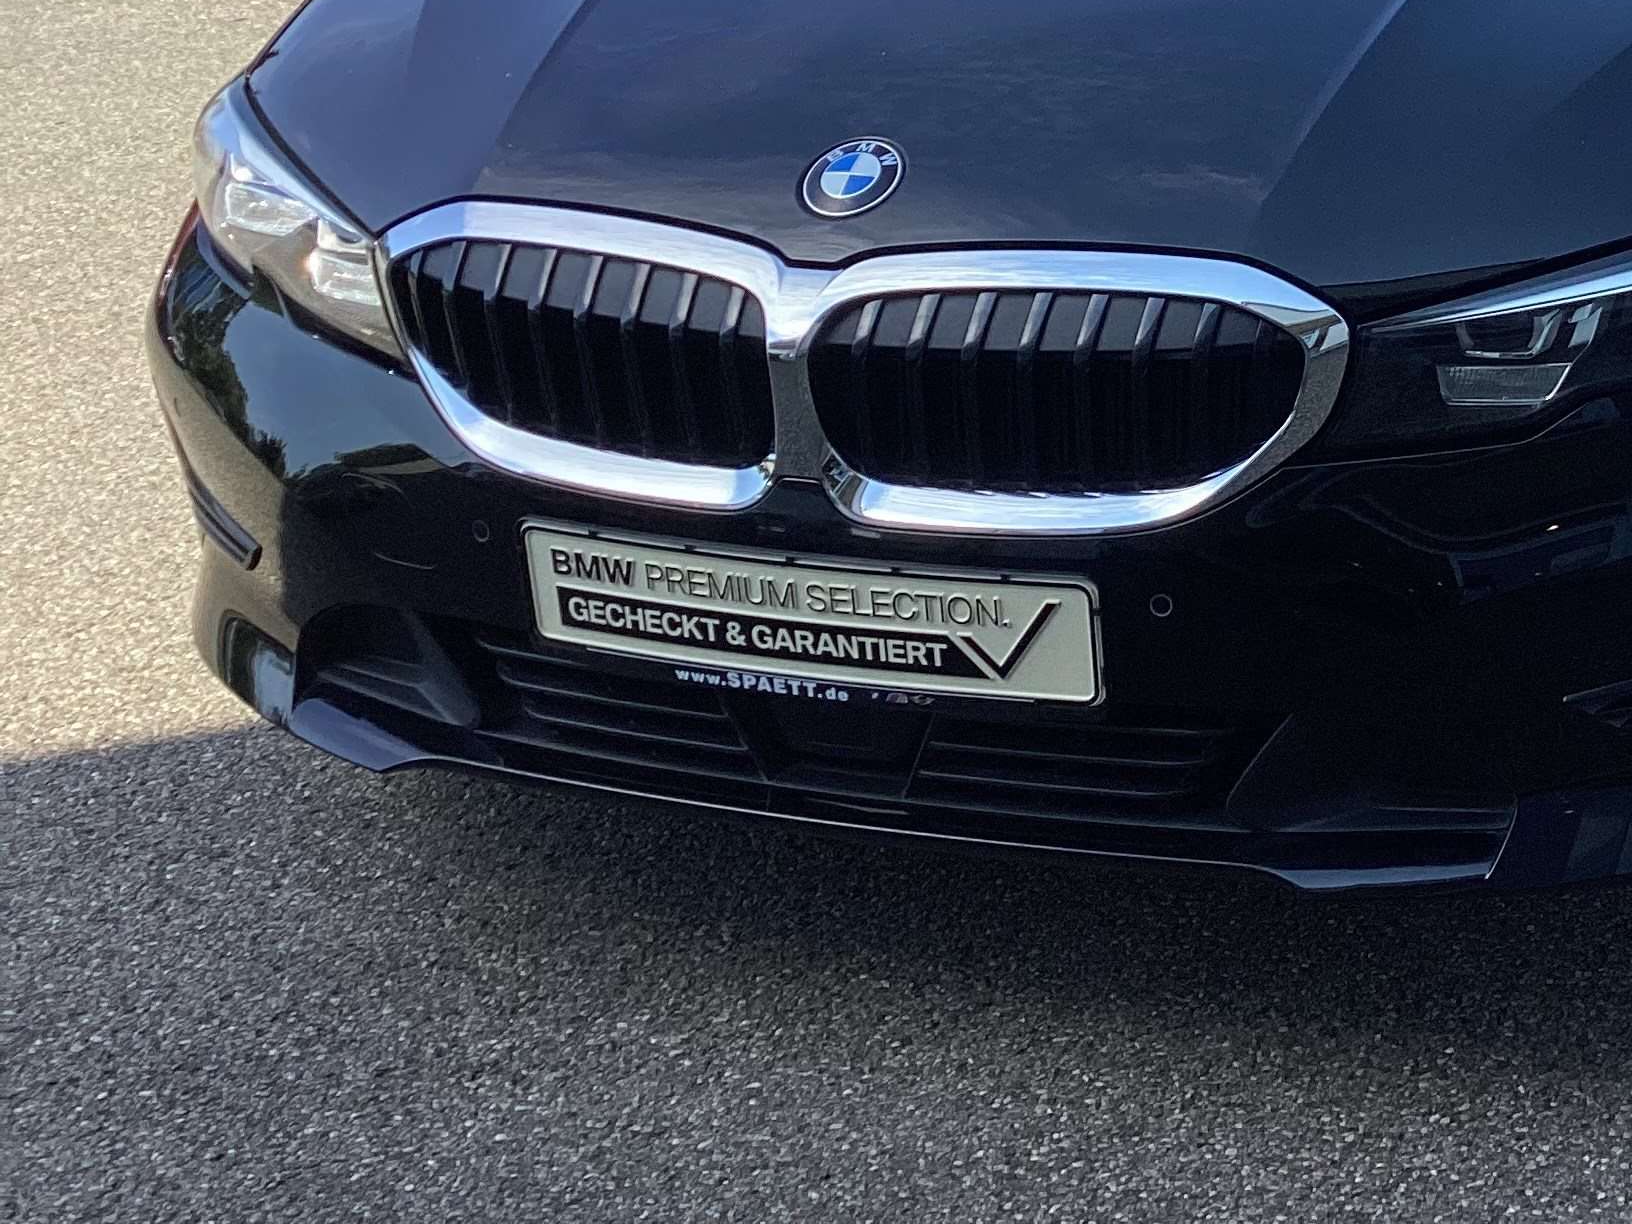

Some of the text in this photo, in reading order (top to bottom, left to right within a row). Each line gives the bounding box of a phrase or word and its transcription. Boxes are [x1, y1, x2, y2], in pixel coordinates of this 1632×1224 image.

[826, 143, 897, 166] BMW
[550, 548, 1012, 628] BMW PREMIUM SELECTION.
[567, 596, 948, 667] GECHECKT & GARANTIERT
[674, 668, 849, 702] www.SPAETT.de
